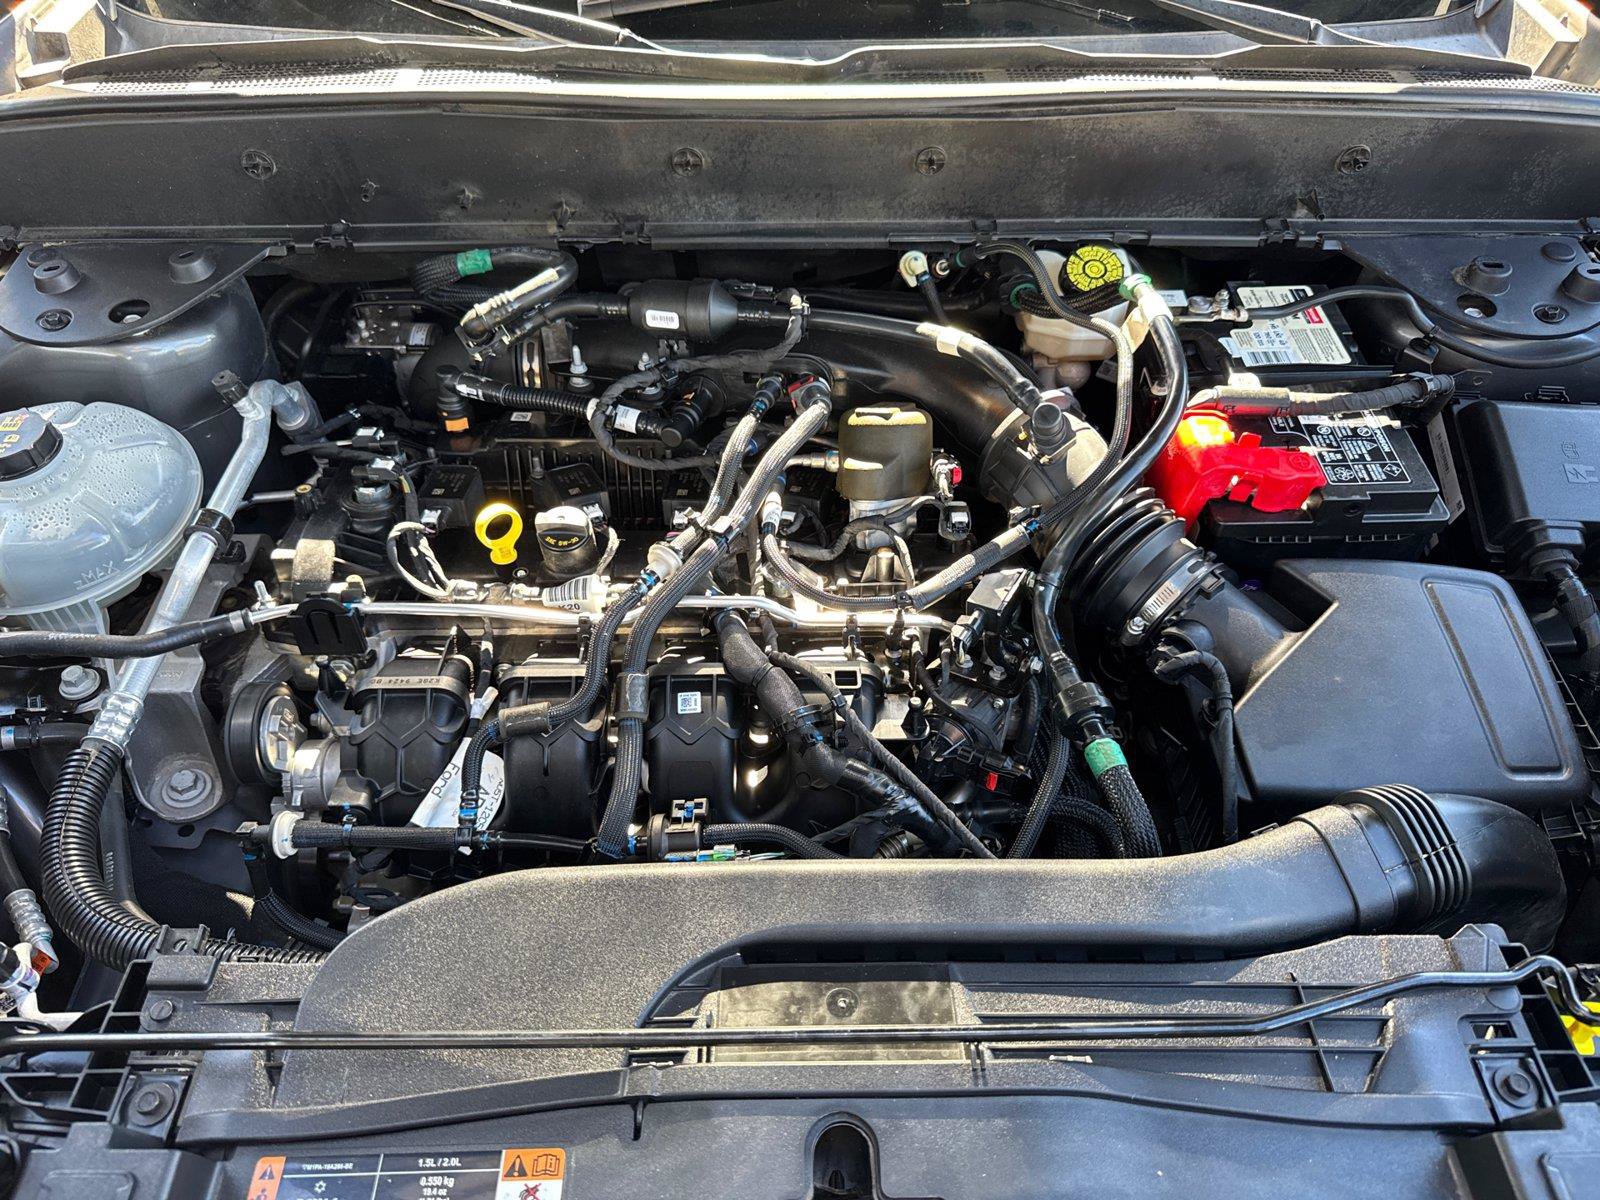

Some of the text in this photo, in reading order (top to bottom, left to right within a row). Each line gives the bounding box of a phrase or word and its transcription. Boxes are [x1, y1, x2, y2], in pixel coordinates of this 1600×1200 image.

[81, 561, 120, 580] MAX
[431, 762, 461, 799] Ford
[418, 1158, 437, 1168] 1.5L
[442, 1157, 462, 1167] 2.0L
[443, 1175, 455, 1188] kg
